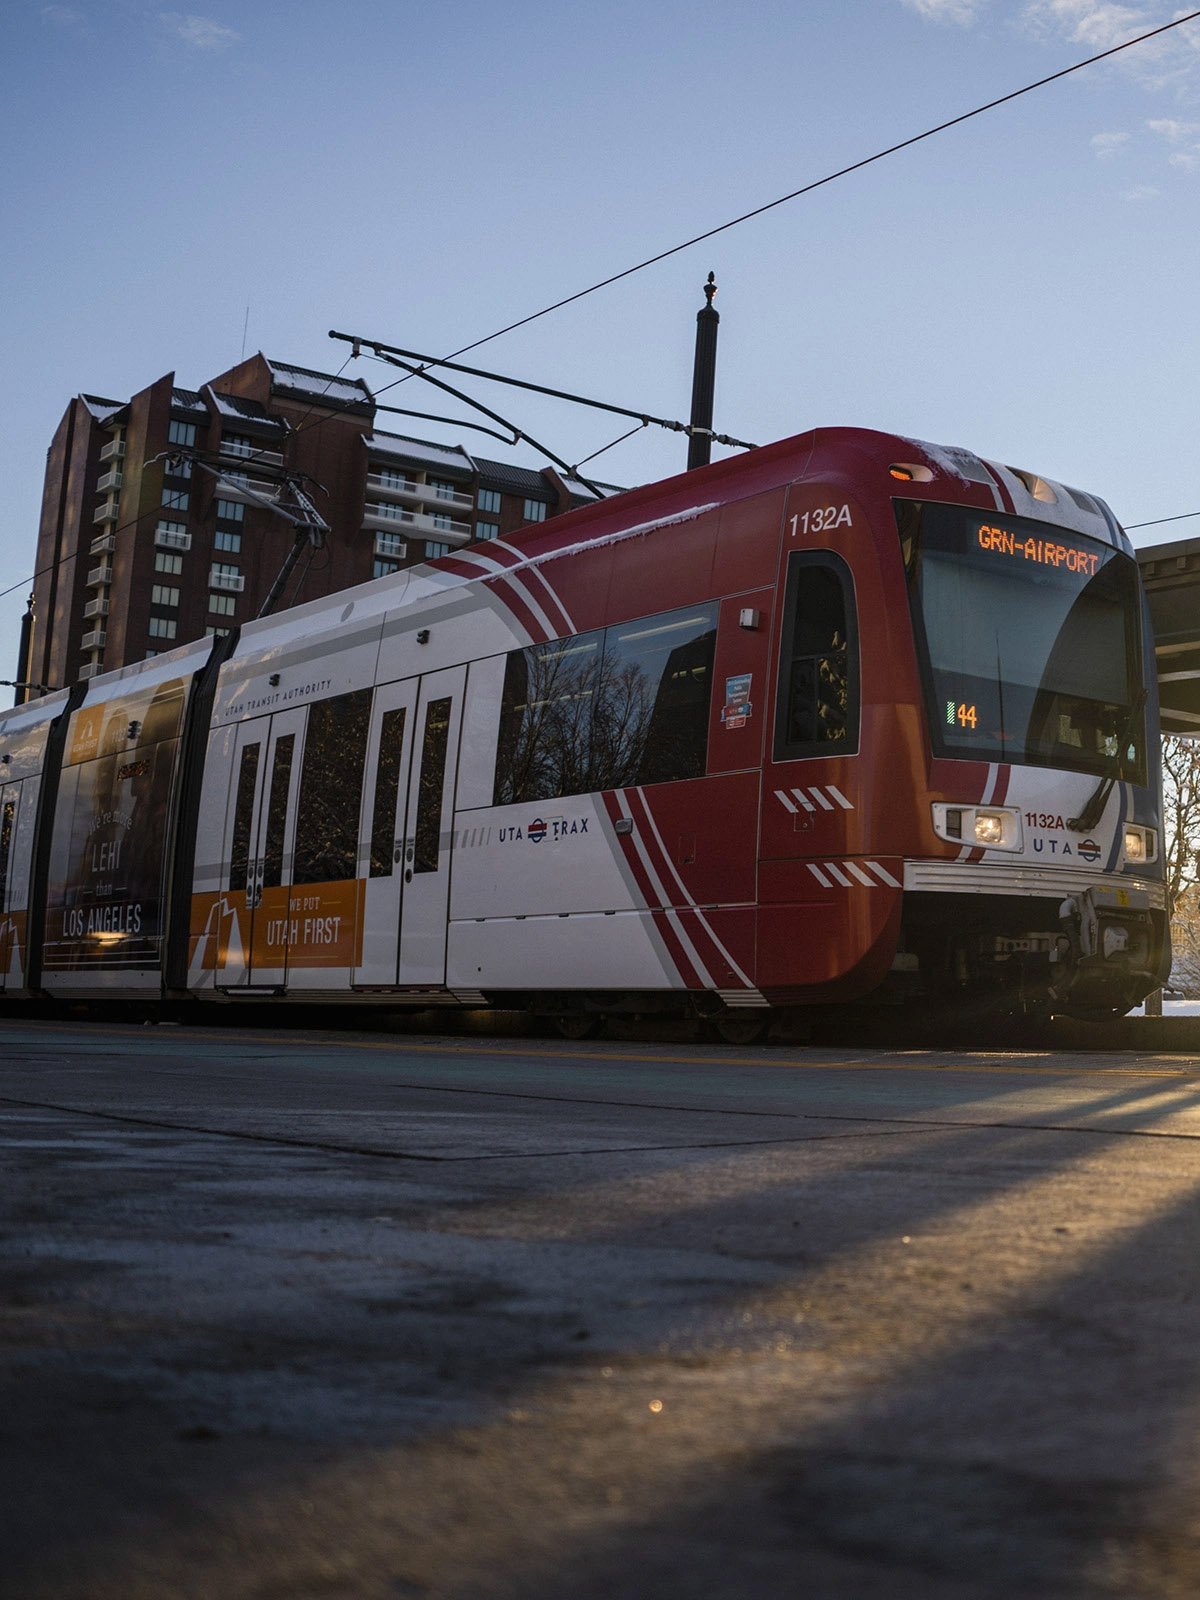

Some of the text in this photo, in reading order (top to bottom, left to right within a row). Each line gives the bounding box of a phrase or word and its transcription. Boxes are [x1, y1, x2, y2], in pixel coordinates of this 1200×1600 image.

[790, 504, 853, 537] 1132A
[978, 525, 1099, 576] GRN-AIRPORT
[225, 680, 332, 717] UTAH TRANSIT AUTHORITY
[957, 703, 977, 729] 44
[499, 818, 589, 842] UTA TRAX
[1025, 812, 1065, 830] 1132A
[92, 839, 122, 872] LEHI
[1033, 838, 1072, 855] UTA
[96, 880, 113, 896] than
[289, 896, 320, 911] WE PUT
[63, 904, 142, 937] LOS ANGELES
[267, 916, 341, 946] UTAH FIRST
